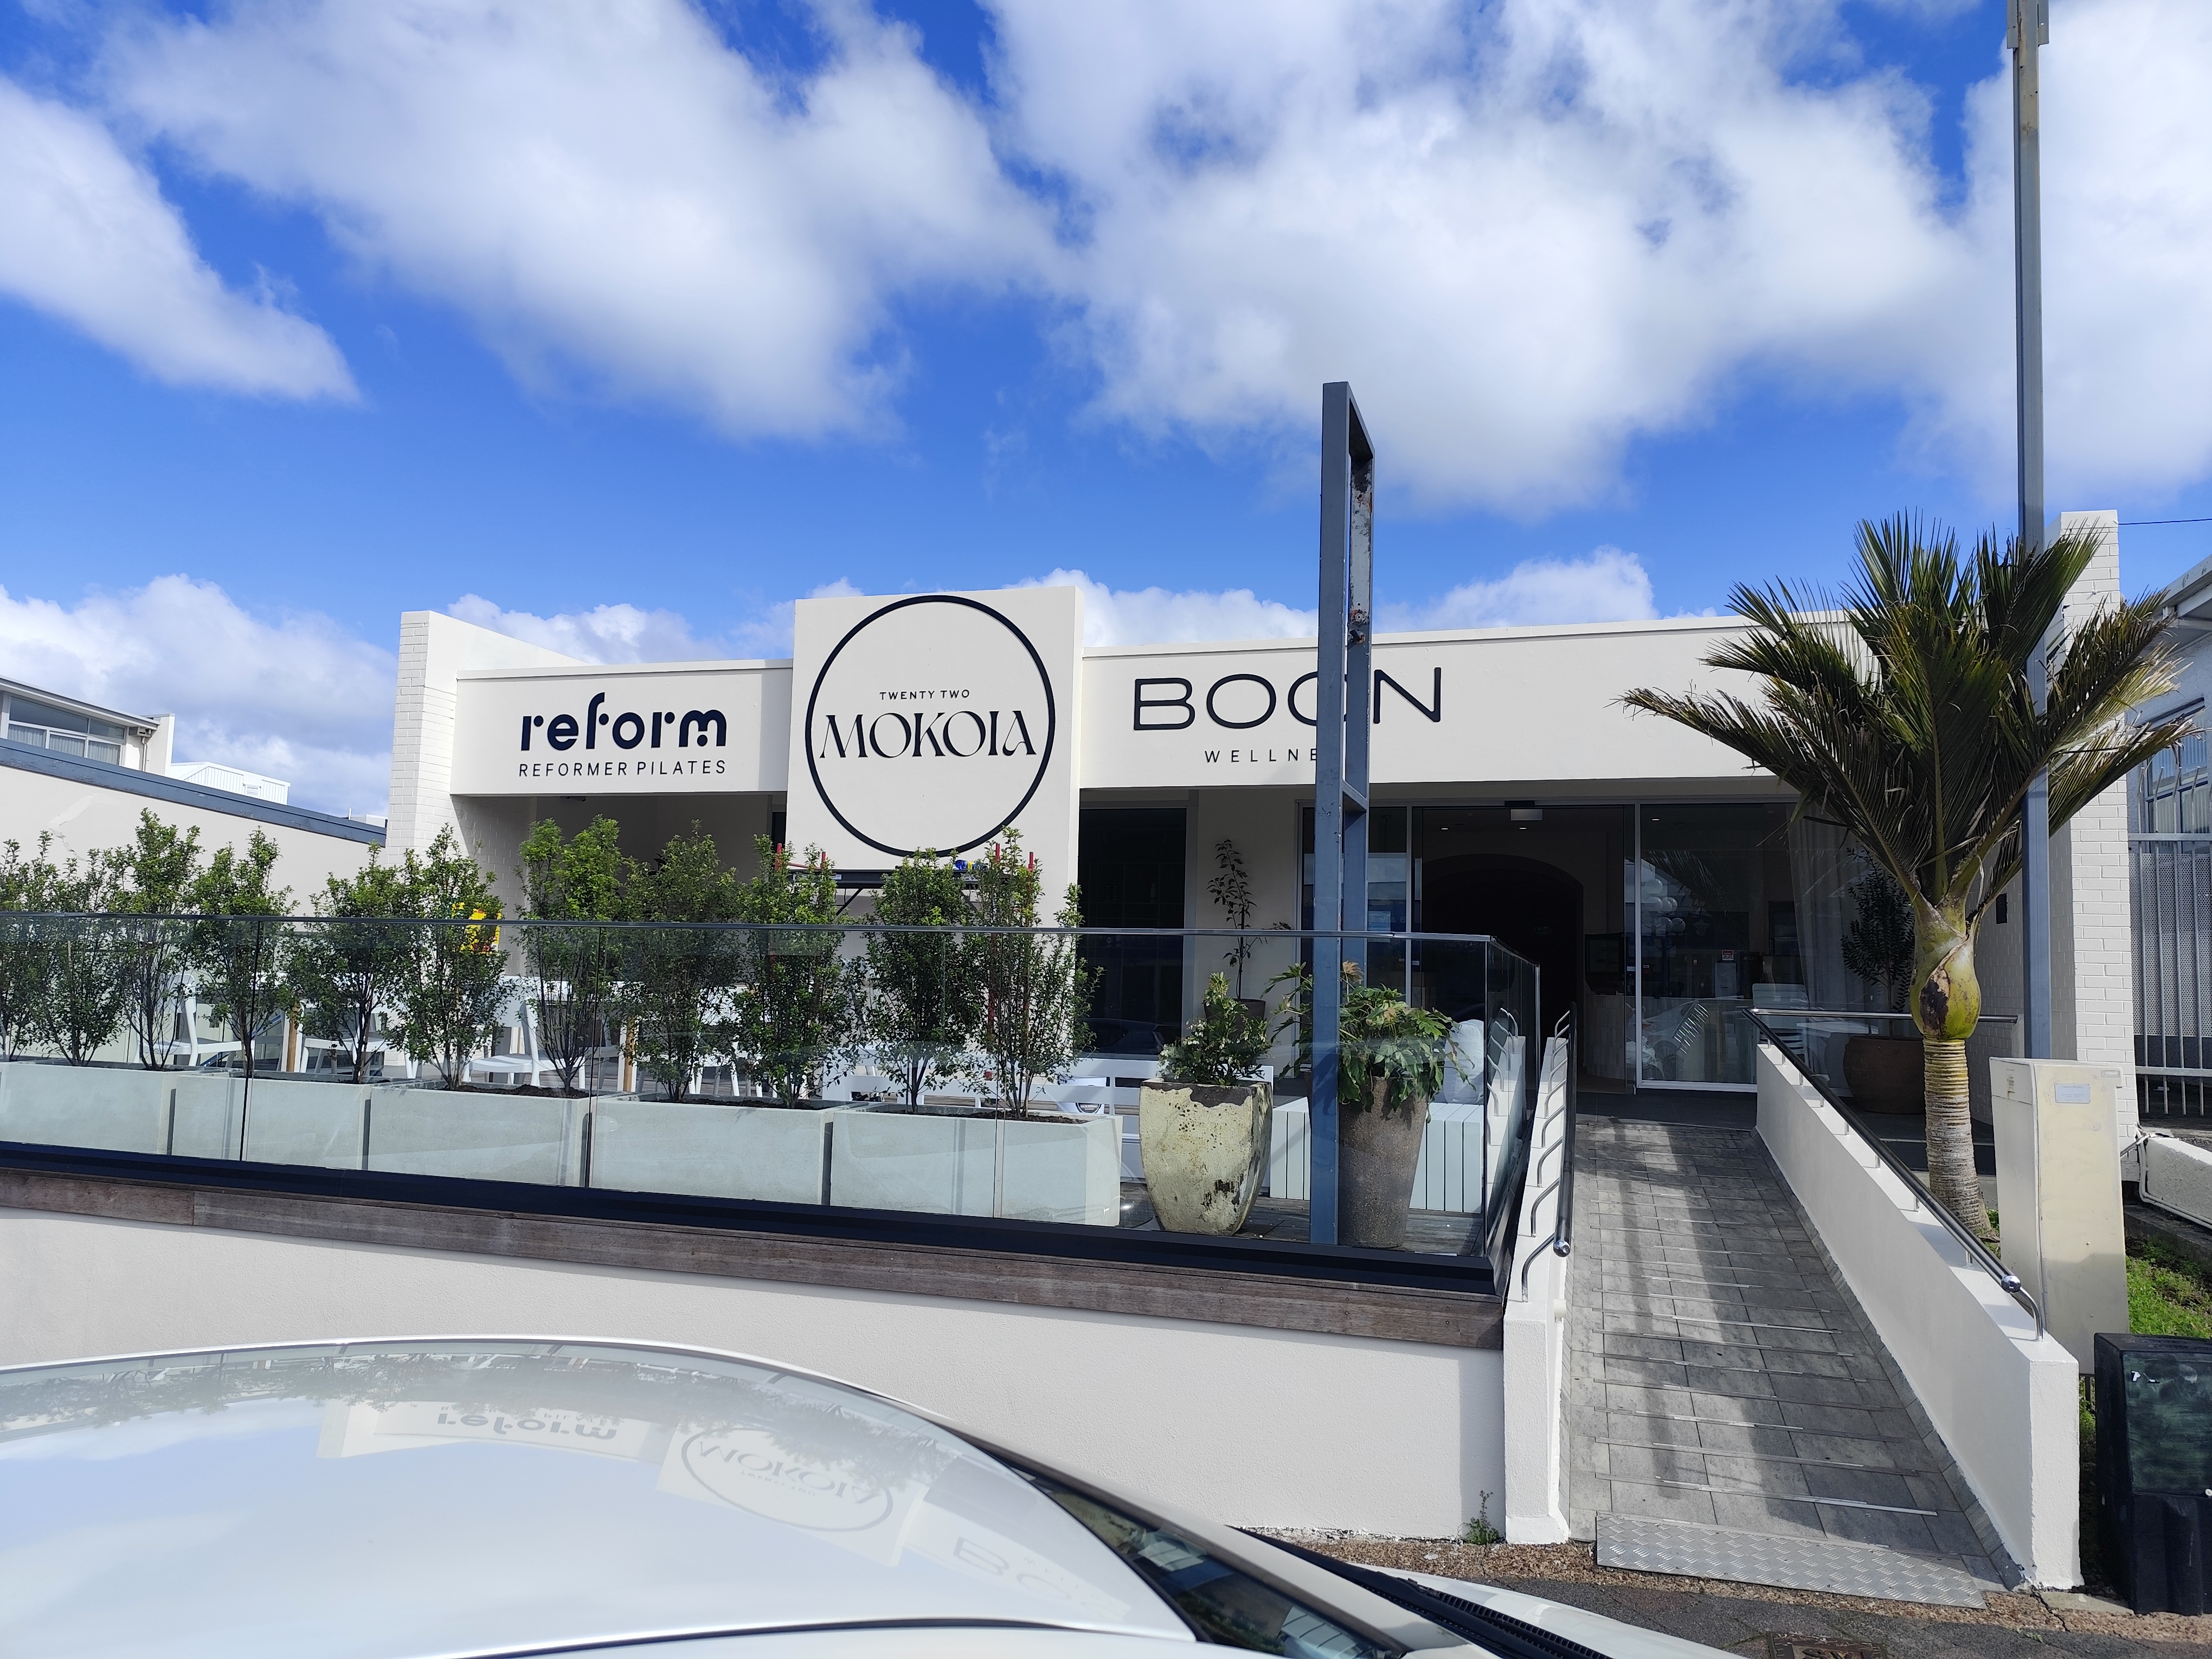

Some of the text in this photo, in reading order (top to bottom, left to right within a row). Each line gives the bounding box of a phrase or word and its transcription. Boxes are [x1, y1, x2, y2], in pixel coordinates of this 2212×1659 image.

[879, 689, 970, 700] TWENTY TWO
[521, 692, 726, 751] reform
[819, 710, 1037, 758] MOKOIA
[1205, 748, 1316, 763] WELLNE
[519, 760, 725, 777] REFORMER PILATES
